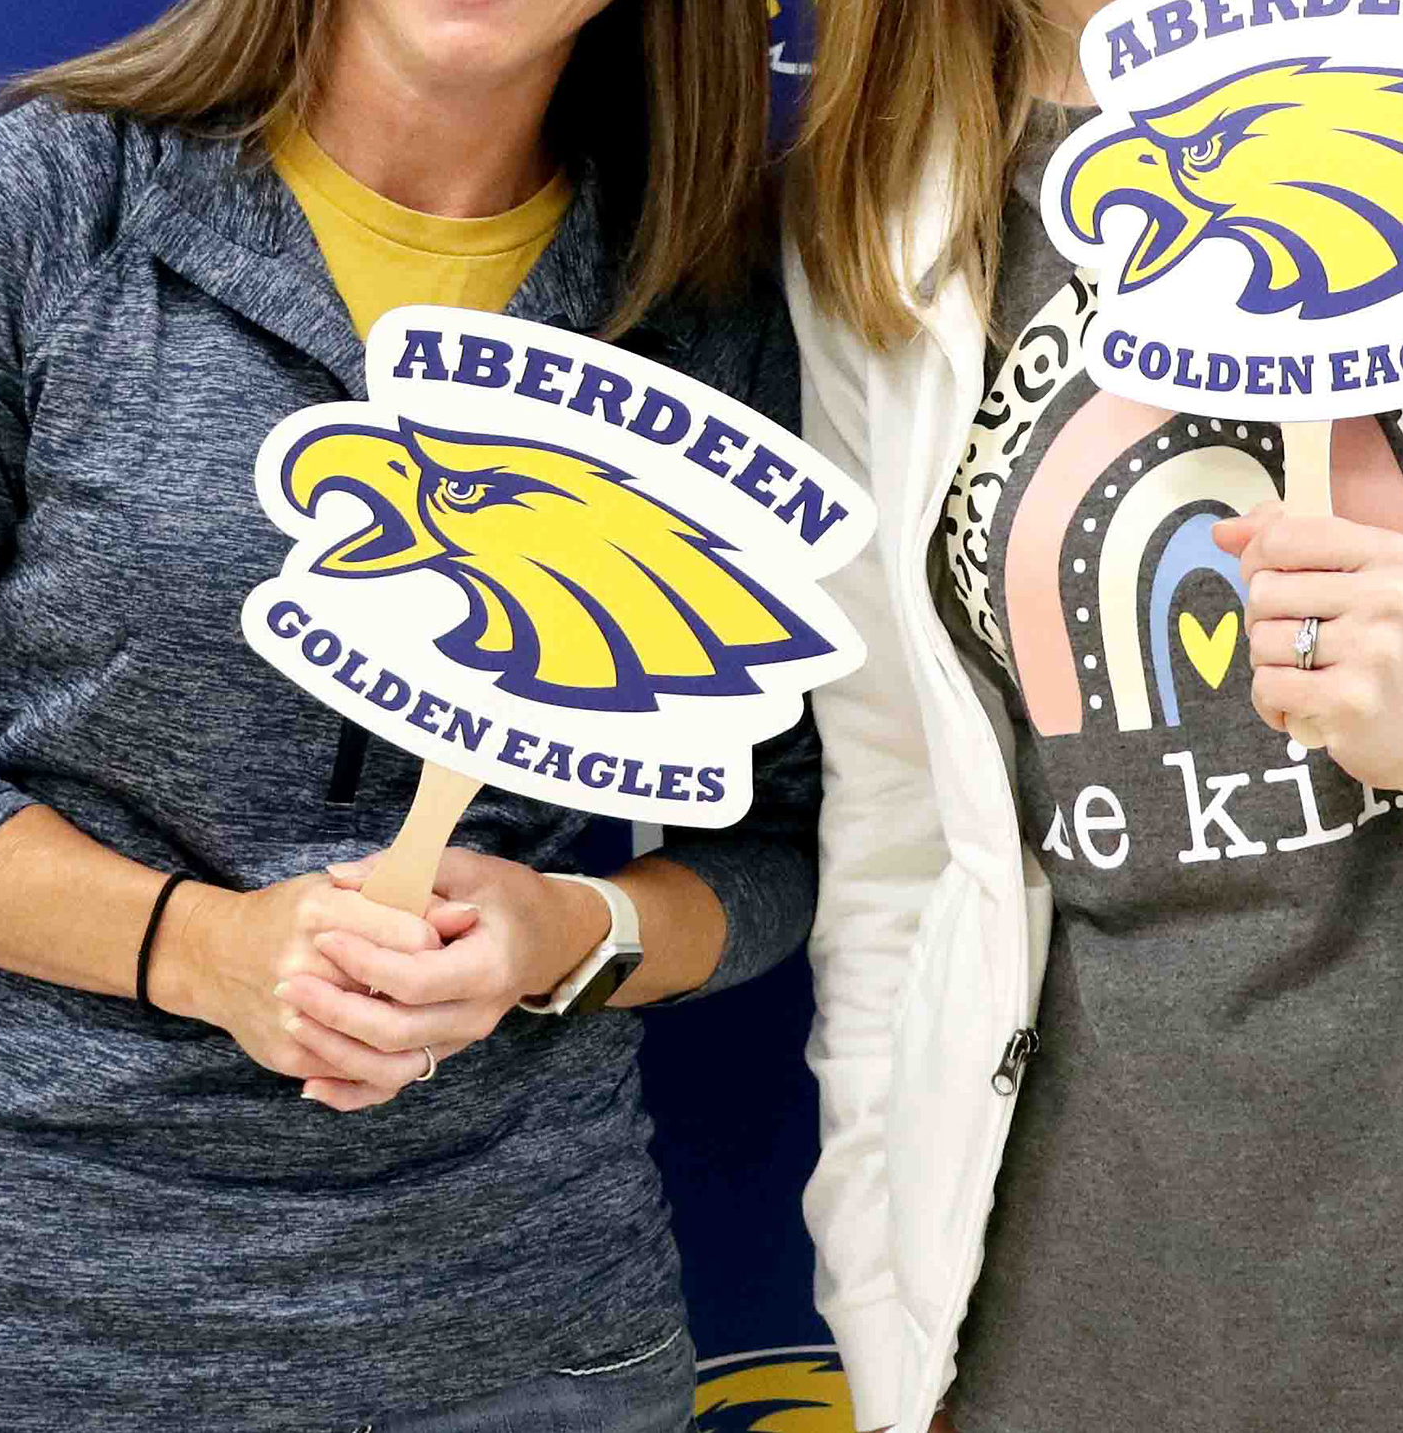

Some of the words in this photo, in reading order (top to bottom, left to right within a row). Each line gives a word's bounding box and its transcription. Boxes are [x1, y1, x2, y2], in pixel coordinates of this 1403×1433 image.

[392, 328, 849, 546] ABERDEEN
[1102, 329, 1315, 396] GOLDEN
[267, 600, 492, 752] GOLDEN
[497, 728, 727, 803] EAGLES
